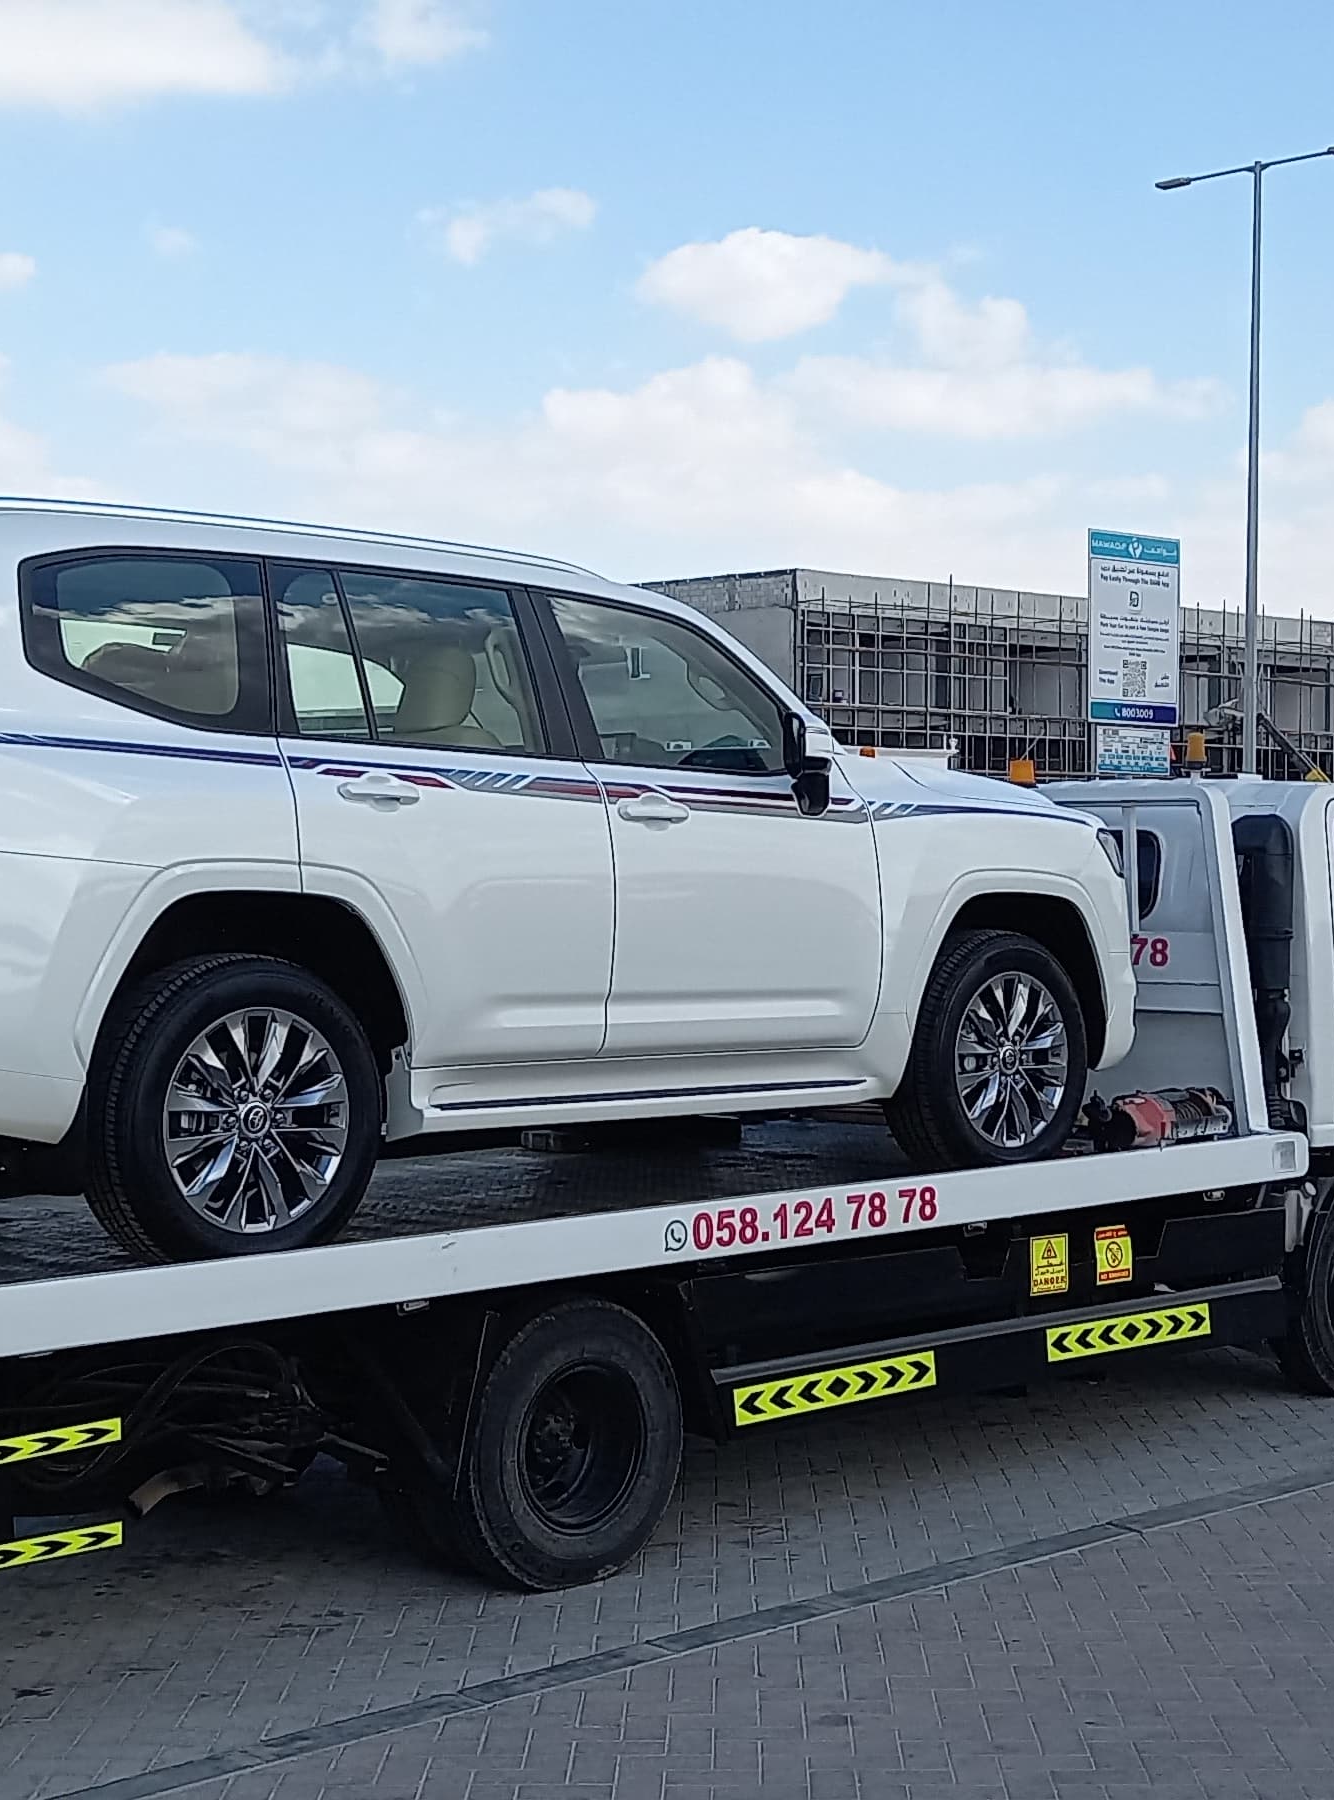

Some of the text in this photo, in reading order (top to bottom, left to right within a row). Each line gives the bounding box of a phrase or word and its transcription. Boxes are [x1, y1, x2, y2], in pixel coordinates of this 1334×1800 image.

[692, 1186, 937, 1250] 058.124 78 78
[1033, 1276, 1068, 1288] DANGER
